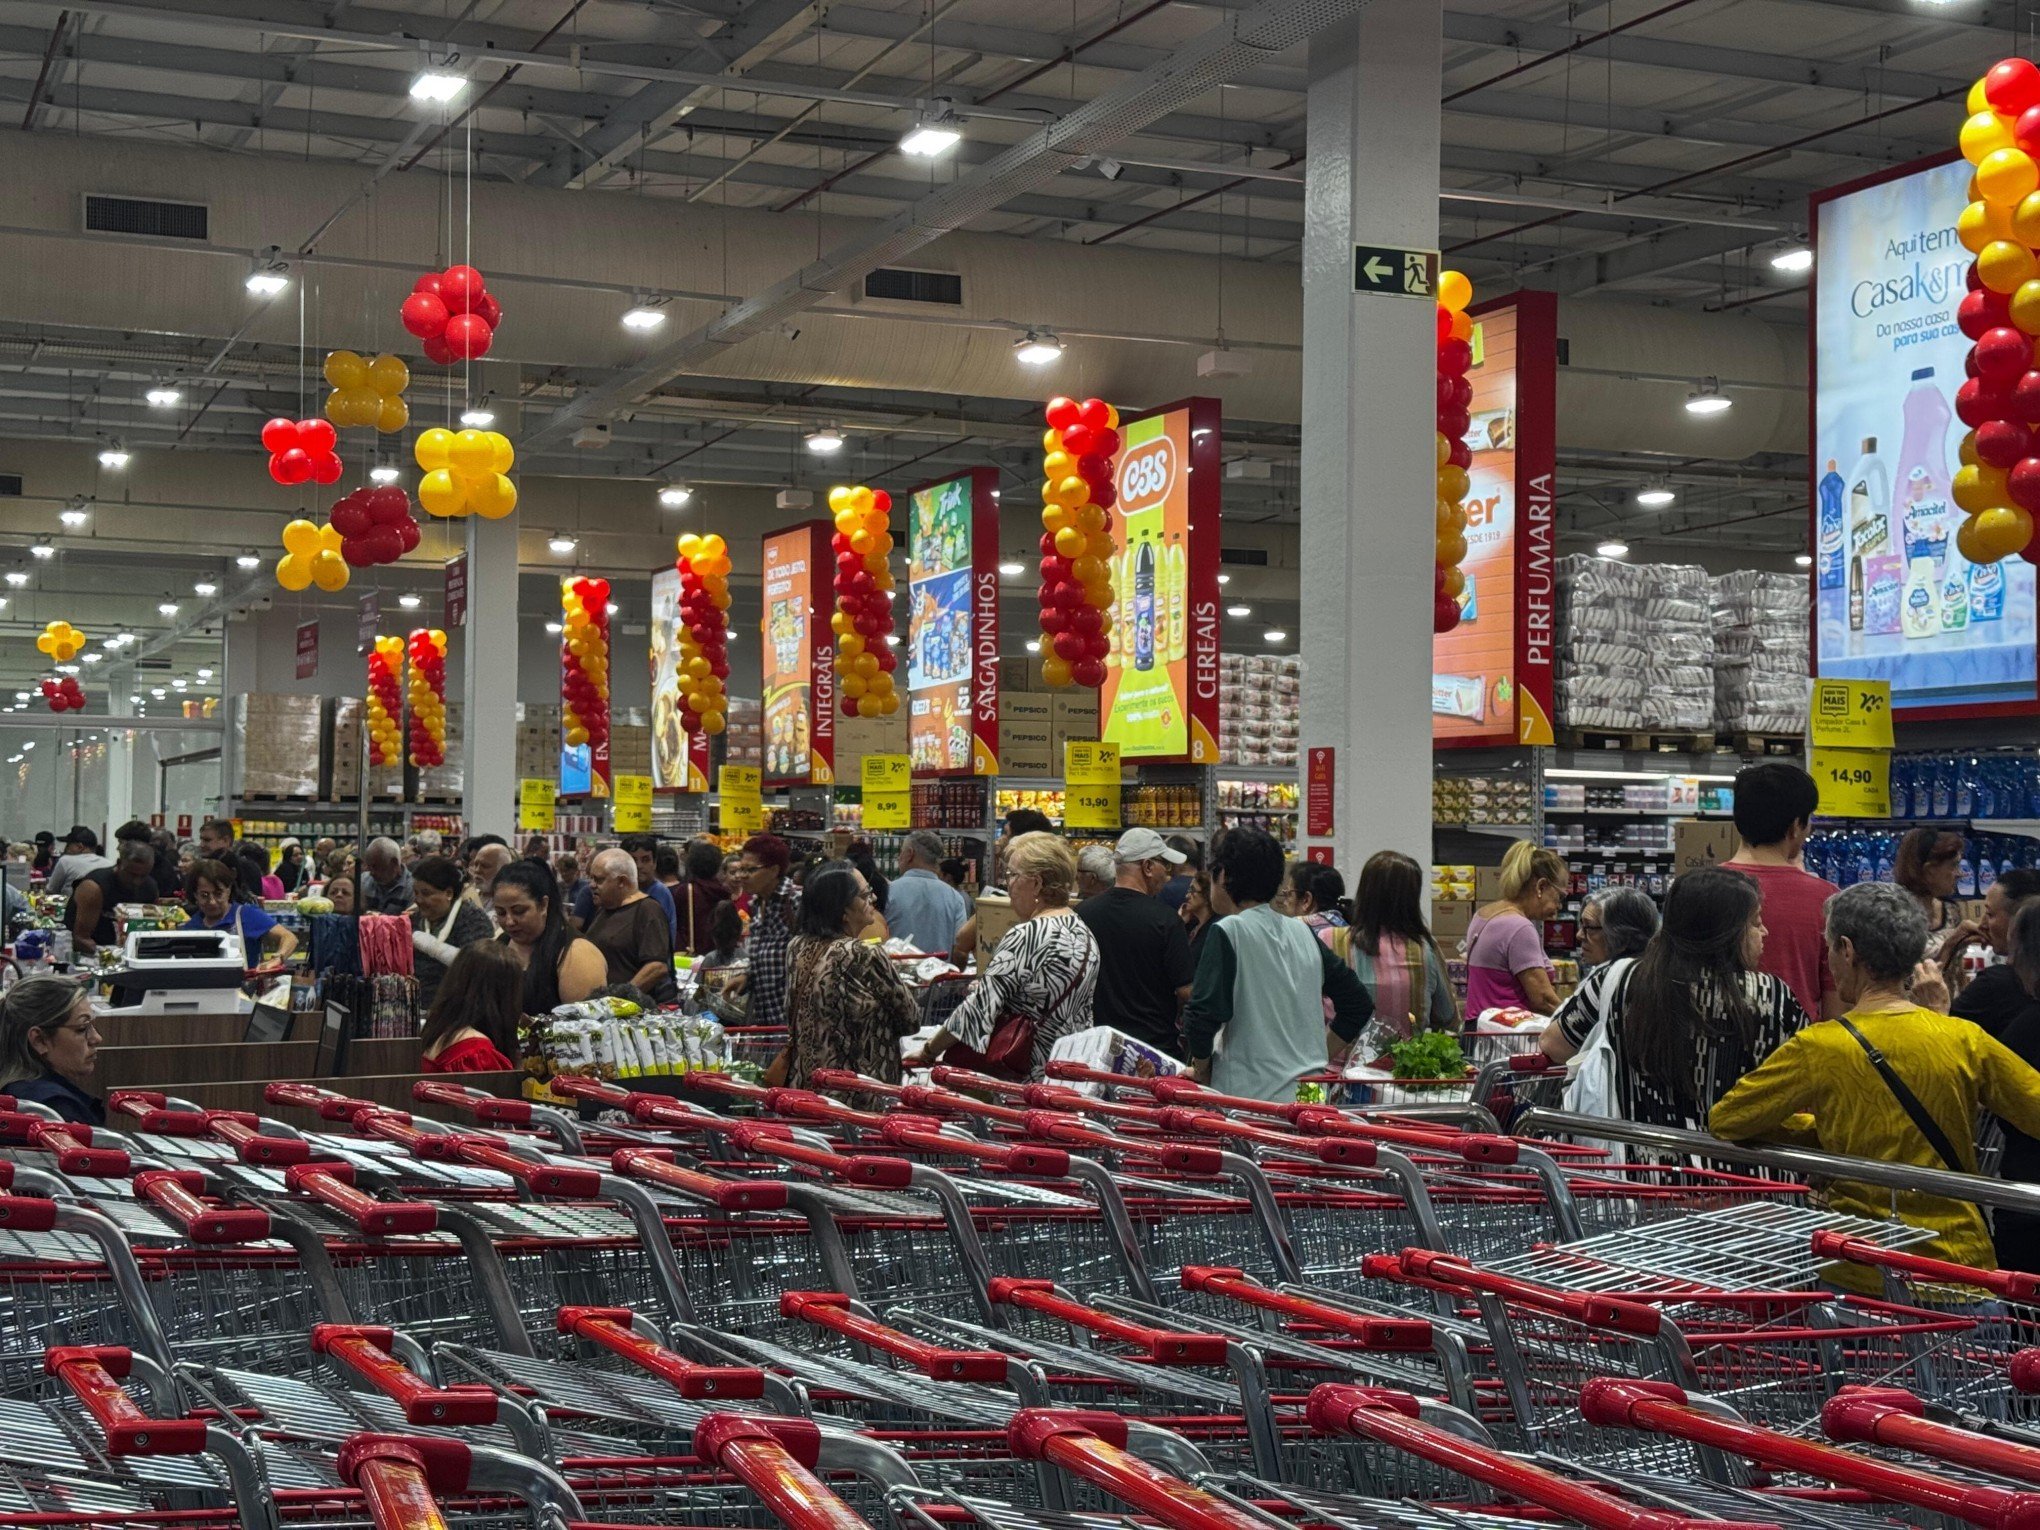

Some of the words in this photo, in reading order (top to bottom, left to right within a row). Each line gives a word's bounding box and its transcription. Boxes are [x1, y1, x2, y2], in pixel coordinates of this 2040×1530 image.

[1885, 234, 1917, 260] Aqui
[1876, 322, 1892, 338] Da
[1893, 315, 1923, 333] nossa
[1925, 310, 1950, 327] casa
[1893, 331, 1918, 351] para
[1920, 326, 1939, 342] sua
[1122, 449, 1168, 502] CBS
[1485, 530, 1501, 542] 1919
[1527, 473, 1551, 665] PERFUMARIA
[1823, 696, 1846, 705] MAIS
[1013, 706, 1048, 714] PEPSICO
[1068, 707, 1098, 715] PEPSIC
[1522, 717, 1534, 740] 7
[1012, 734, 1047, 742] PEPSICO
[1193, 740, 1205, 759] 8
[976, 756, 985, 772] 9
[814, 767, 829, 780] 10
[1830, 768, 1872, 785] 14,90
[690, 778, 700, 788] 11
[594, 785, 604, 795] 12
[877, 802, 897, 811] 8,99
[1079, 797, 1108, 808] 13,90
